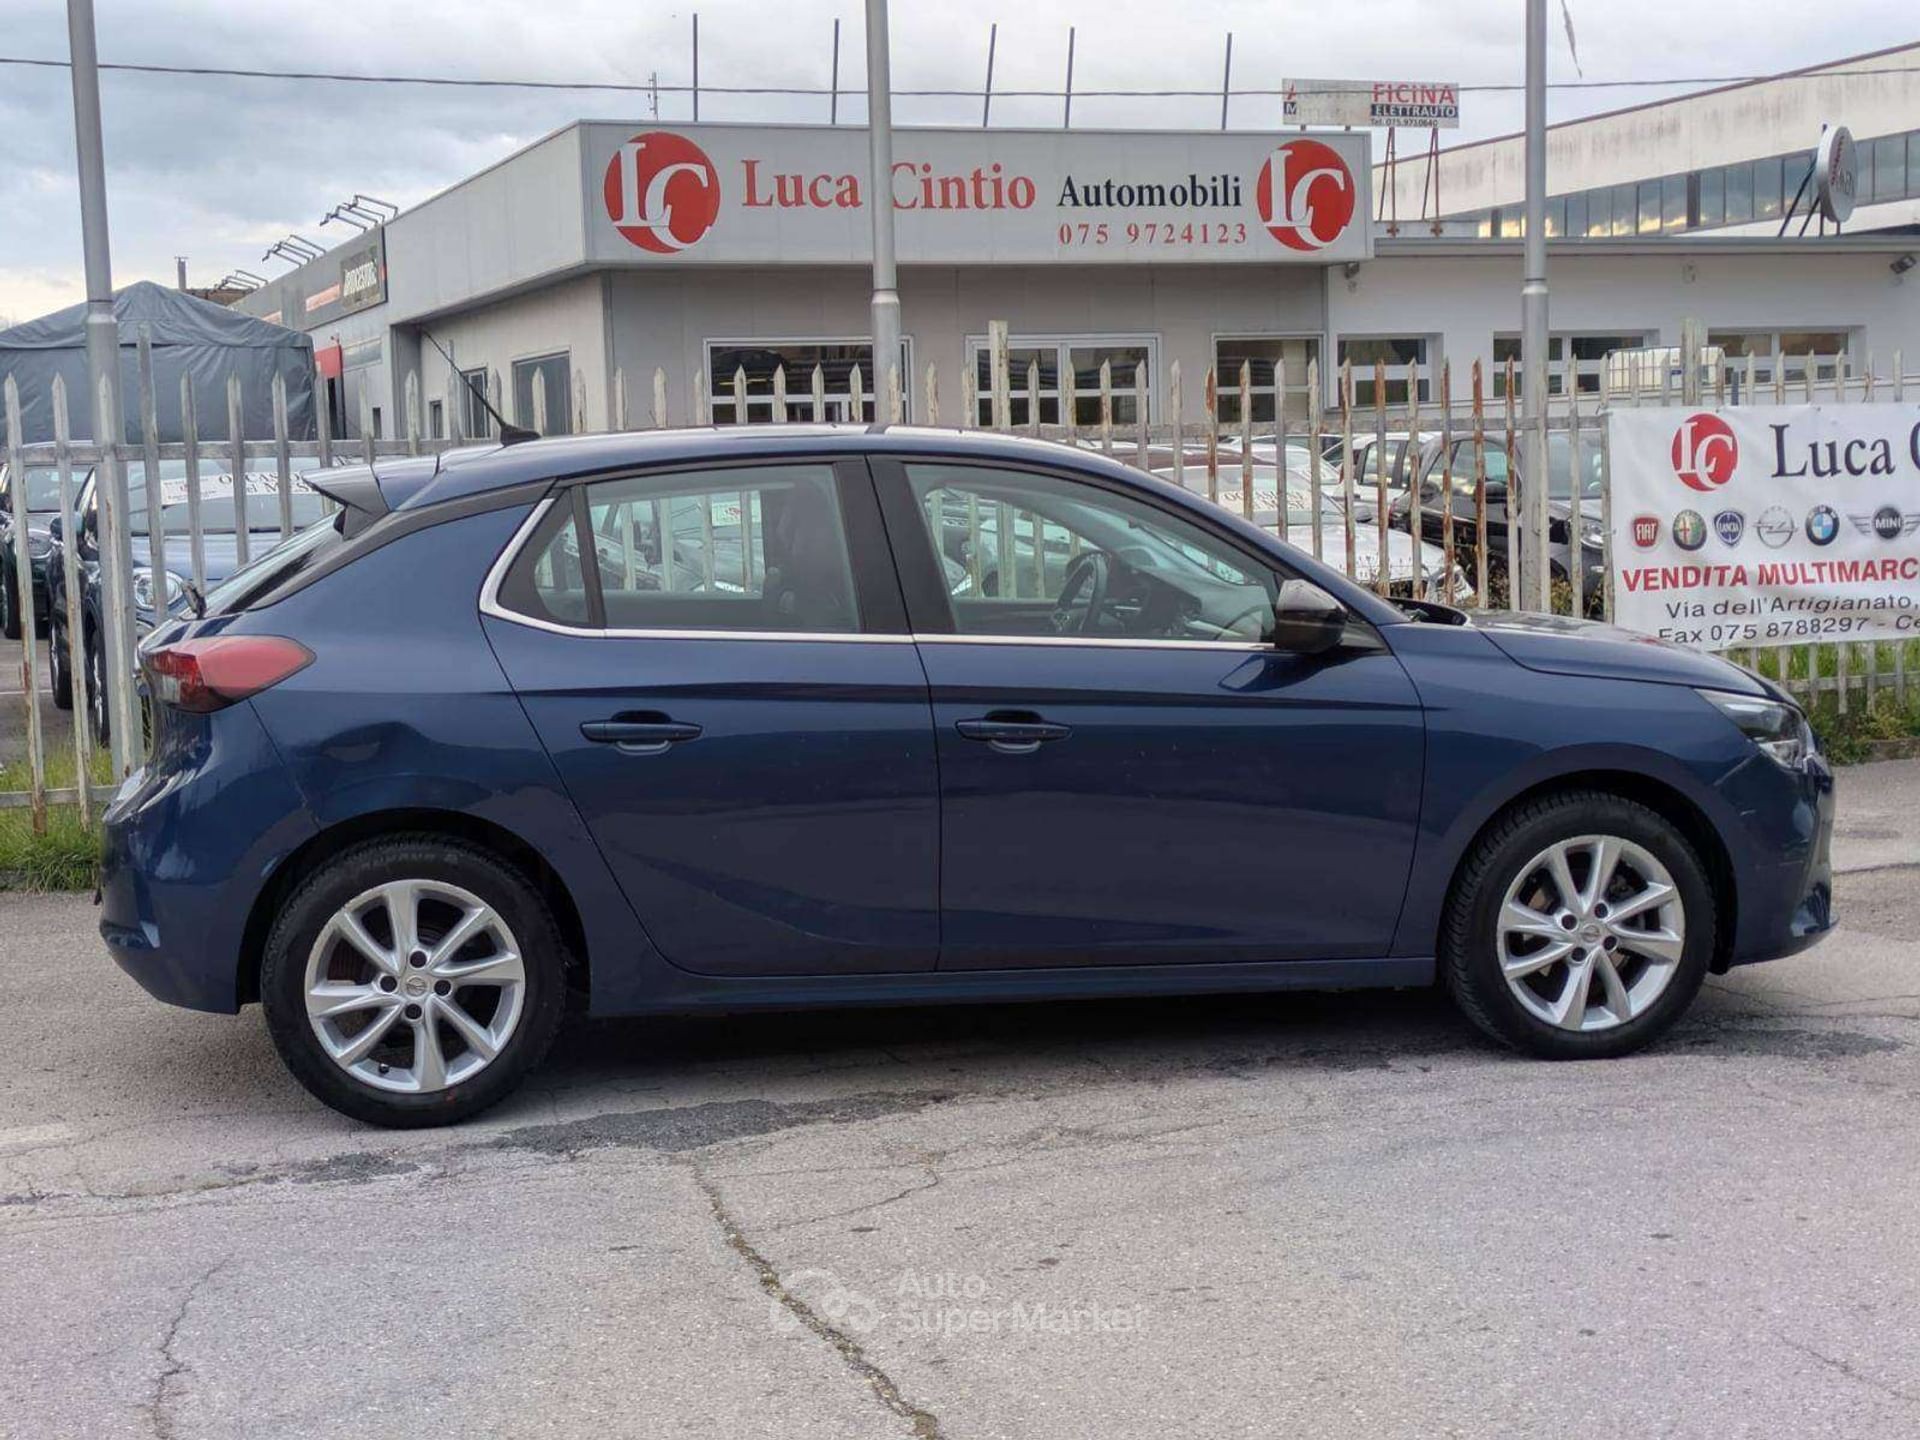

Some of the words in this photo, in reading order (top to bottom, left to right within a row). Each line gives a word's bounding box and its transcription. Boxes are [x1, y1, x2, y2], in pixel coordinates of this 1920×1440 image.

[1375, 105, 1456, 117] ELETTRAUTO
[741, 159, 863, 208] Luca
[891, 162, 1036, 210] Cintio
[1056, 174, 1242, 207] Automobili
[1059, 223, 1109, 245] 075
[1126, 222, 1247, 245] 9724123
[1769, 423, 1896, 478] Luca
[1635, 523, 1657, 541] FIAT
[1875, 518, 1901, 529] MINI
[1622, 565, 1748, 592] VENDITA
[1758, 557, 1919, 587] MULTIMARC
[1666, 601, 1706, 619] Via
[1713, 595, 1919, 616] dell'Artigianato,
[1659, 627, 1702, 645] Fax
[1711, 624, 1757, 642] 075
[1766, 617, 1870, 639] 8788297
